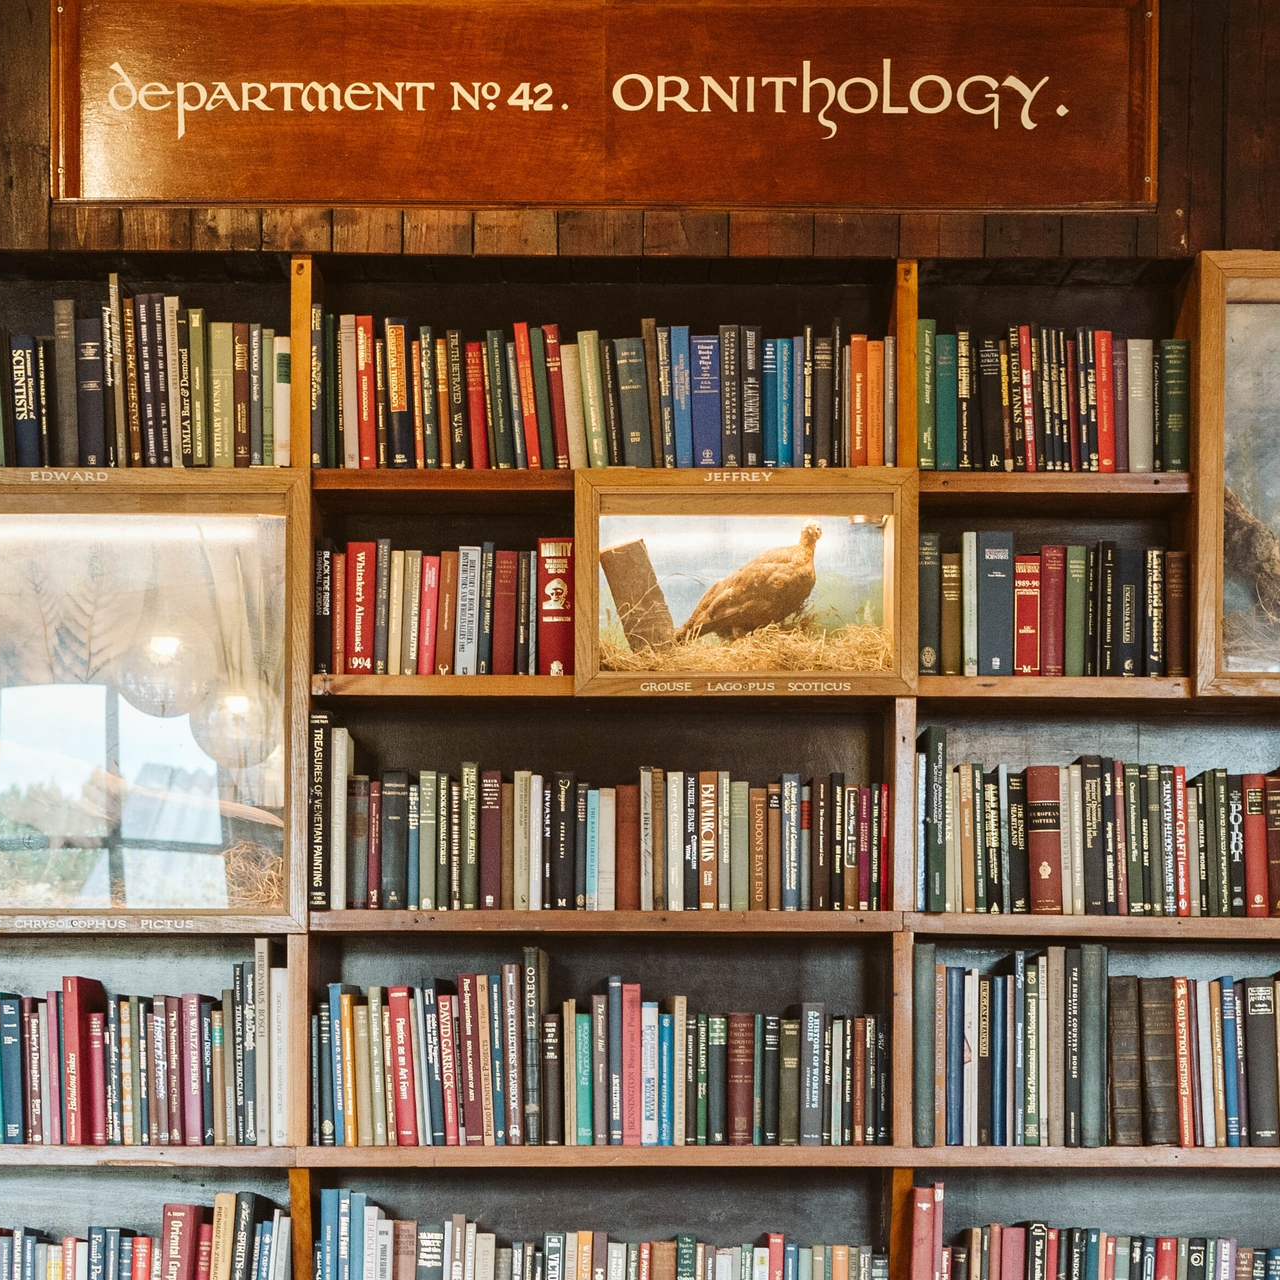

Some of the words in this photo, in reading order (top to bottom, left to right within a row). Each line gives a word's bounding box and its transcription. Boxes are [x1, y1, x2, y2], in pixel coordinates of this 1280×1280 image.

[451, 333, 460, 360] TRUTH
[1010, 326, 1020, 347] THE
[179, 348, 189, 386] Desmond
[1011, 350, 1020, 383] TIGER
[13, 350, 27, 420] SCIENTISTS
[181, 387, 190, 397] &
[452, 363, 462, 404] BETRAYED
[181, 398, 190, 416] Barr
[1012, 387, 1022, 422] TANKS
[182, 420, 192, 454] SIMLA
[30, 471, 108, 481] EDWARD
[704, 472, 772, 482] JEFFREY
[355, 552, 365, 602] Whitaker's
[354, 605, 364, 652] Almanack
[349, 658, 371, 669] 1994
[640, 683, 691, 692] GROUSE
[788, 683, 851, 692] SCOTICUS
[313, 729, 322, 783] TREASURES
[313, 785, 322, 796] OF
[313, 798, 322, 842] VENETIAN
[701, 784, 715, 861] BEAUMARCHAIS
[755, 804, 764, 851] LONDON'S
[313, 845, 322, 887] PAINTING
[755, 854, 764, 877] EAST
[755, 881, 764, 901] END
[140, 919, 193, 929] PICTUS
[257, 952, 265, 1004] HIERONYMUS
[189, 998, 197, 1016] THE
[440, 1001, 450, 1036] DAVID
[508, 1001, 516, 1014] CAR
[257, 1009, 265, 1037] BOSCH
[398, 1018, 406, 1044] Plastics
[398, 1046, 404, 1054] as
[508, 1018, 517, 1066] COLLECTORS'
[190, 1051, 198, 1095] EMPERORS
[398, 1056, 405, 1064] an
[399, 1067, 408, 1078] Art
[441, 1038, 452, 1088] GARRICK
[400, 1081, 408, 1099] Form
[509, 1069, 518, 1109] YEARBOOK
[169, 1221, 182, 1258] Oriental
[236, 1232, 247, 1269] SPIRITS
[1034, 1240, 1043, 1255] The
